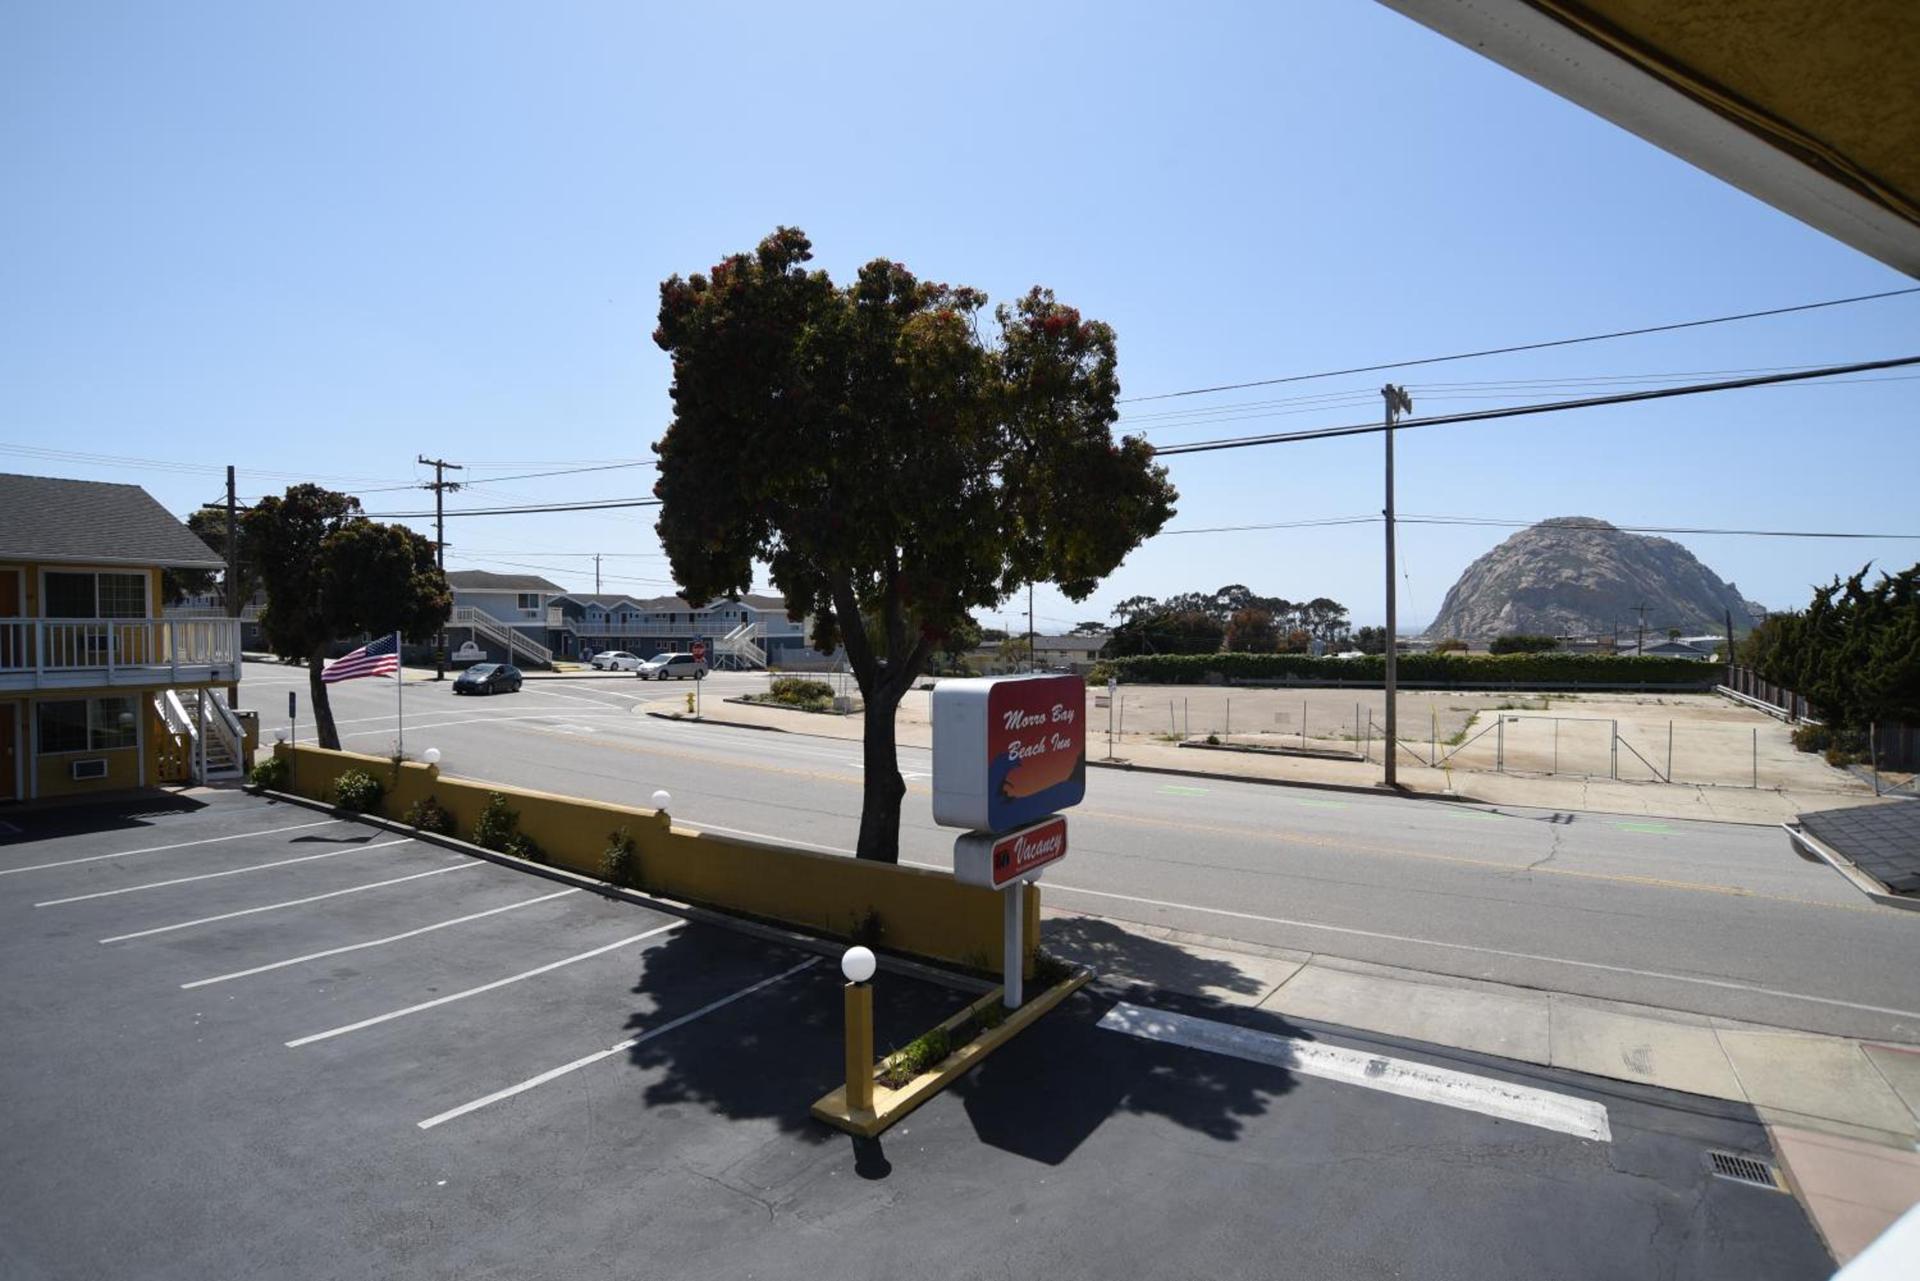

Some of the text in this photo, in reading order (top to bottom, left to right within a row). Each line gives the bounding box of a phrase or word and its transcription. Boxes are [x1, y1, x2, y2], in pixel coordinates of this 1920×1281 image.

[1003, 703, 1075, 731] Morro Bay
[1008, 732, 1071, 761] Beach Inn
[1014, 835, 1062, 865] Vacancy
